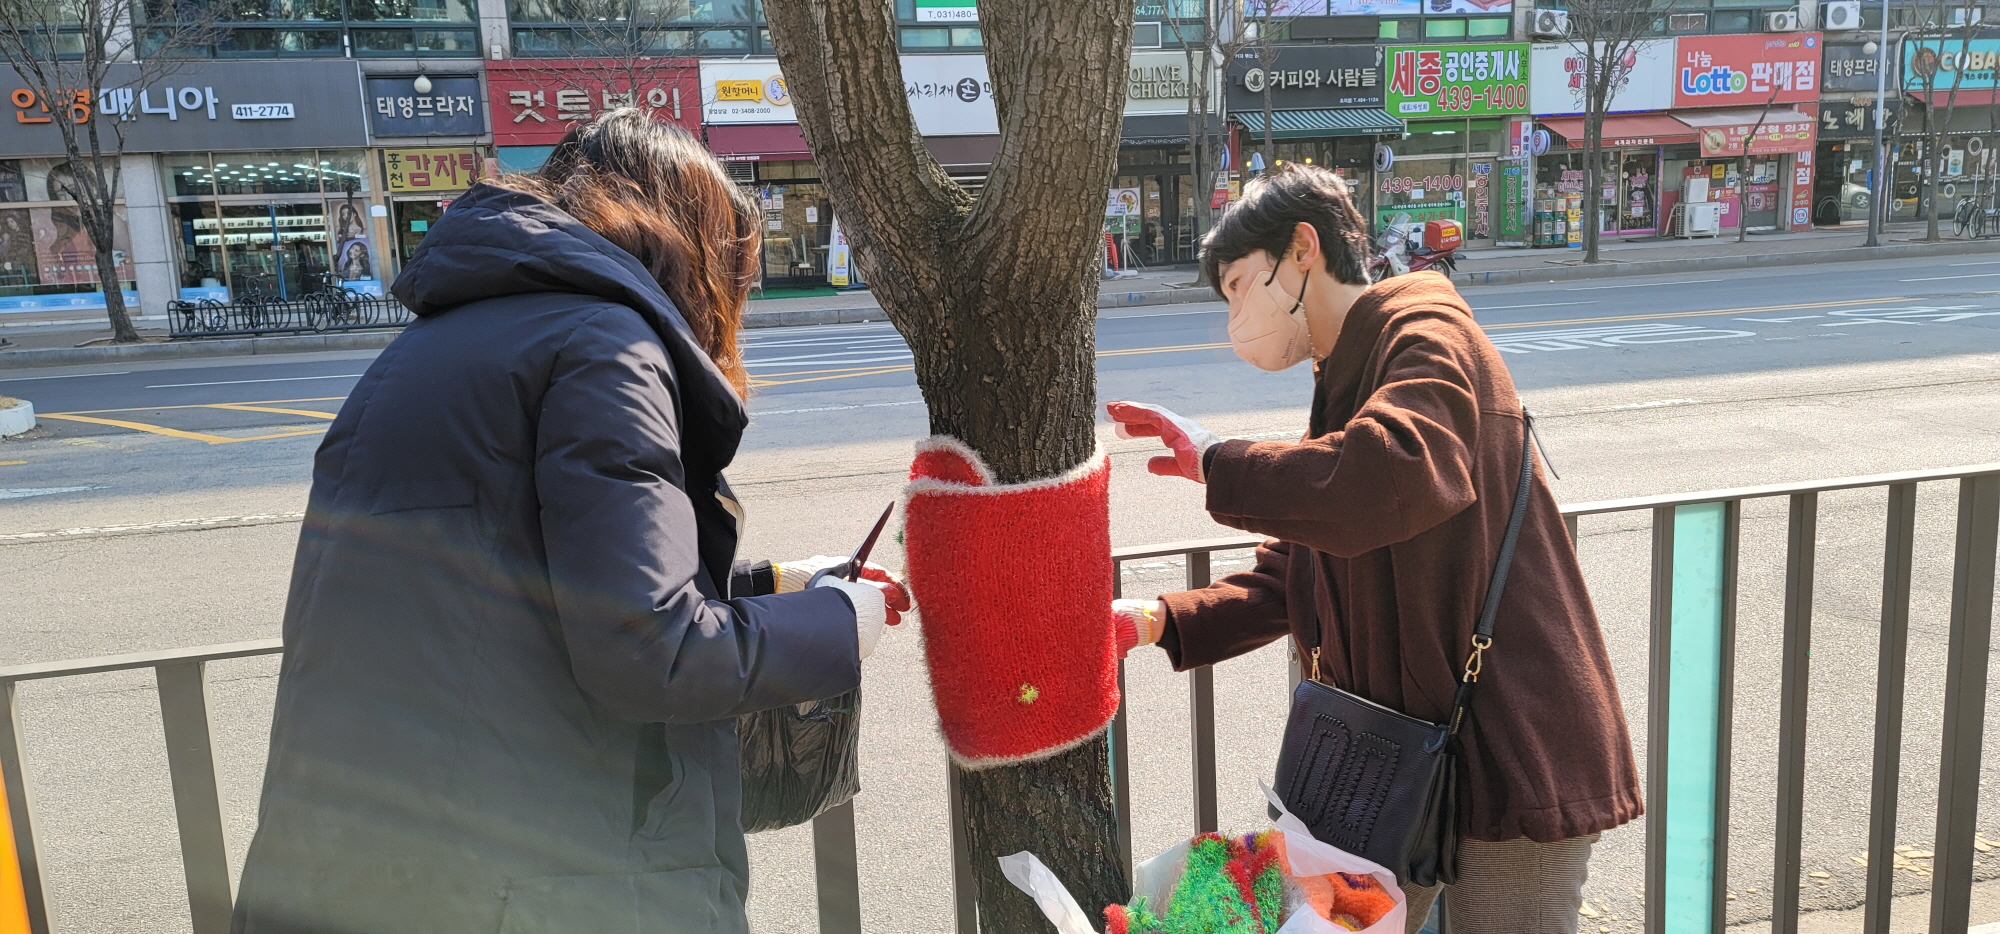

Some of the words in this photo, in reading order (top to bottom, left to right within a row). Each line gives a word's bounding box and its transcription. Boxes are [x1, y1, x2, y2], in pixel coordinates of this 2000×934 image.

[1687, 51, 1712, 68] 나눔
[1940, 50, 2000, 72] COBA
[1129, 65, 1182, 82] OLIVE
[1269, 69, 1321, 89] 커피와
[1326, 67, 1378, 88] 사람들
[1389, 50, 1443, 97] 세종
[1445, 49, 1519, 82] 공인중개사
[1520, 49, 1528, 80] 사무소
[1682, 66, 1747, 95] Lotto
[1751, 61, 1815, 93] 판매점
[721, 85, 759, 97] 원할머니
[1437, 83, 1527, 112] 439-1400
[235, 105, 290, 117] 411-2774
[376, 94, 475, 119] 태영프라자
[387, 153, 404, 189] 홍천
[1472, 163, 1491, 174] 세종
[1380, 174, 1463, 194] 439-1400
[1475, 174, 1489, 236] 공인중개사
